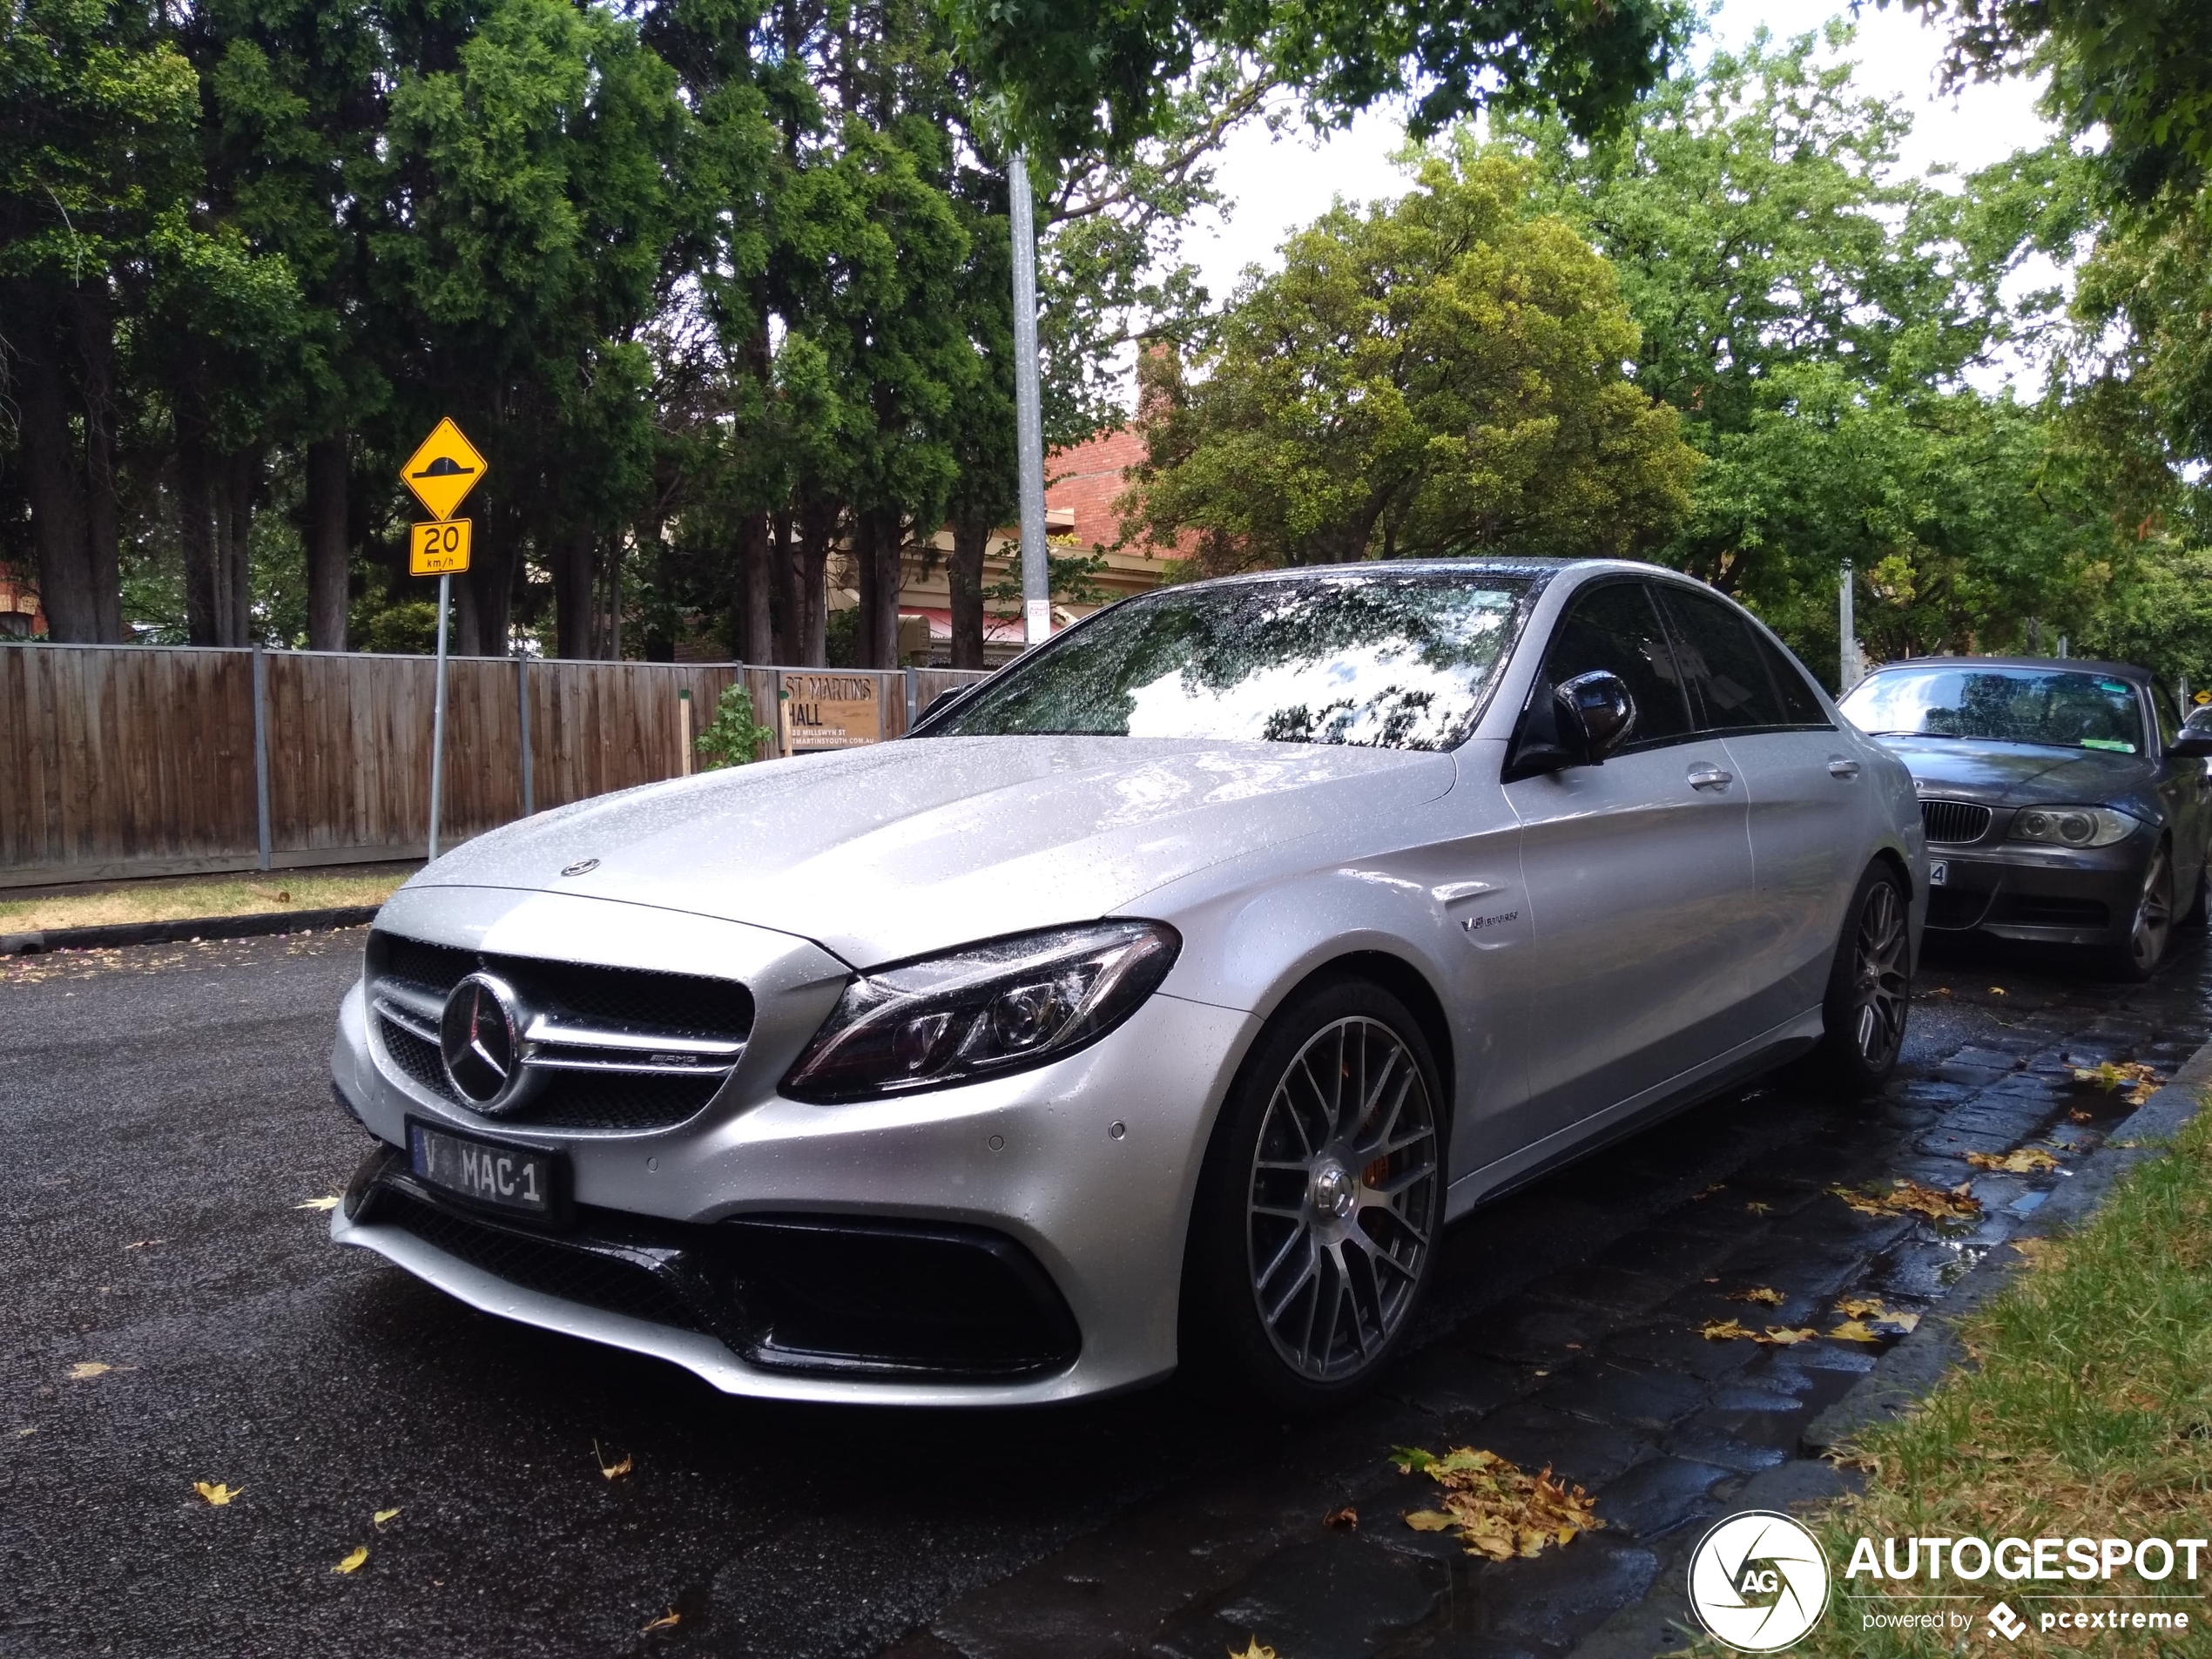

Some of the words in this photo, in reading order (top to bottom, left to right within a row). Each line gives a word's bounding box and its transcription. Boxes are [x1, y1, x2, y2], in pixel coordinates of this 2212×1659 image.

[423, 526, 459, 554] 20
[427, 557, 454, 568] km/h
[786, 677, 803, 700] ST
[809, 677, 872, 702] MARTINS
[788, 703, 823, 726] HALL
[1931, 866, 1944, 882] 4
[664, 1055, 698, 1063] AMG
